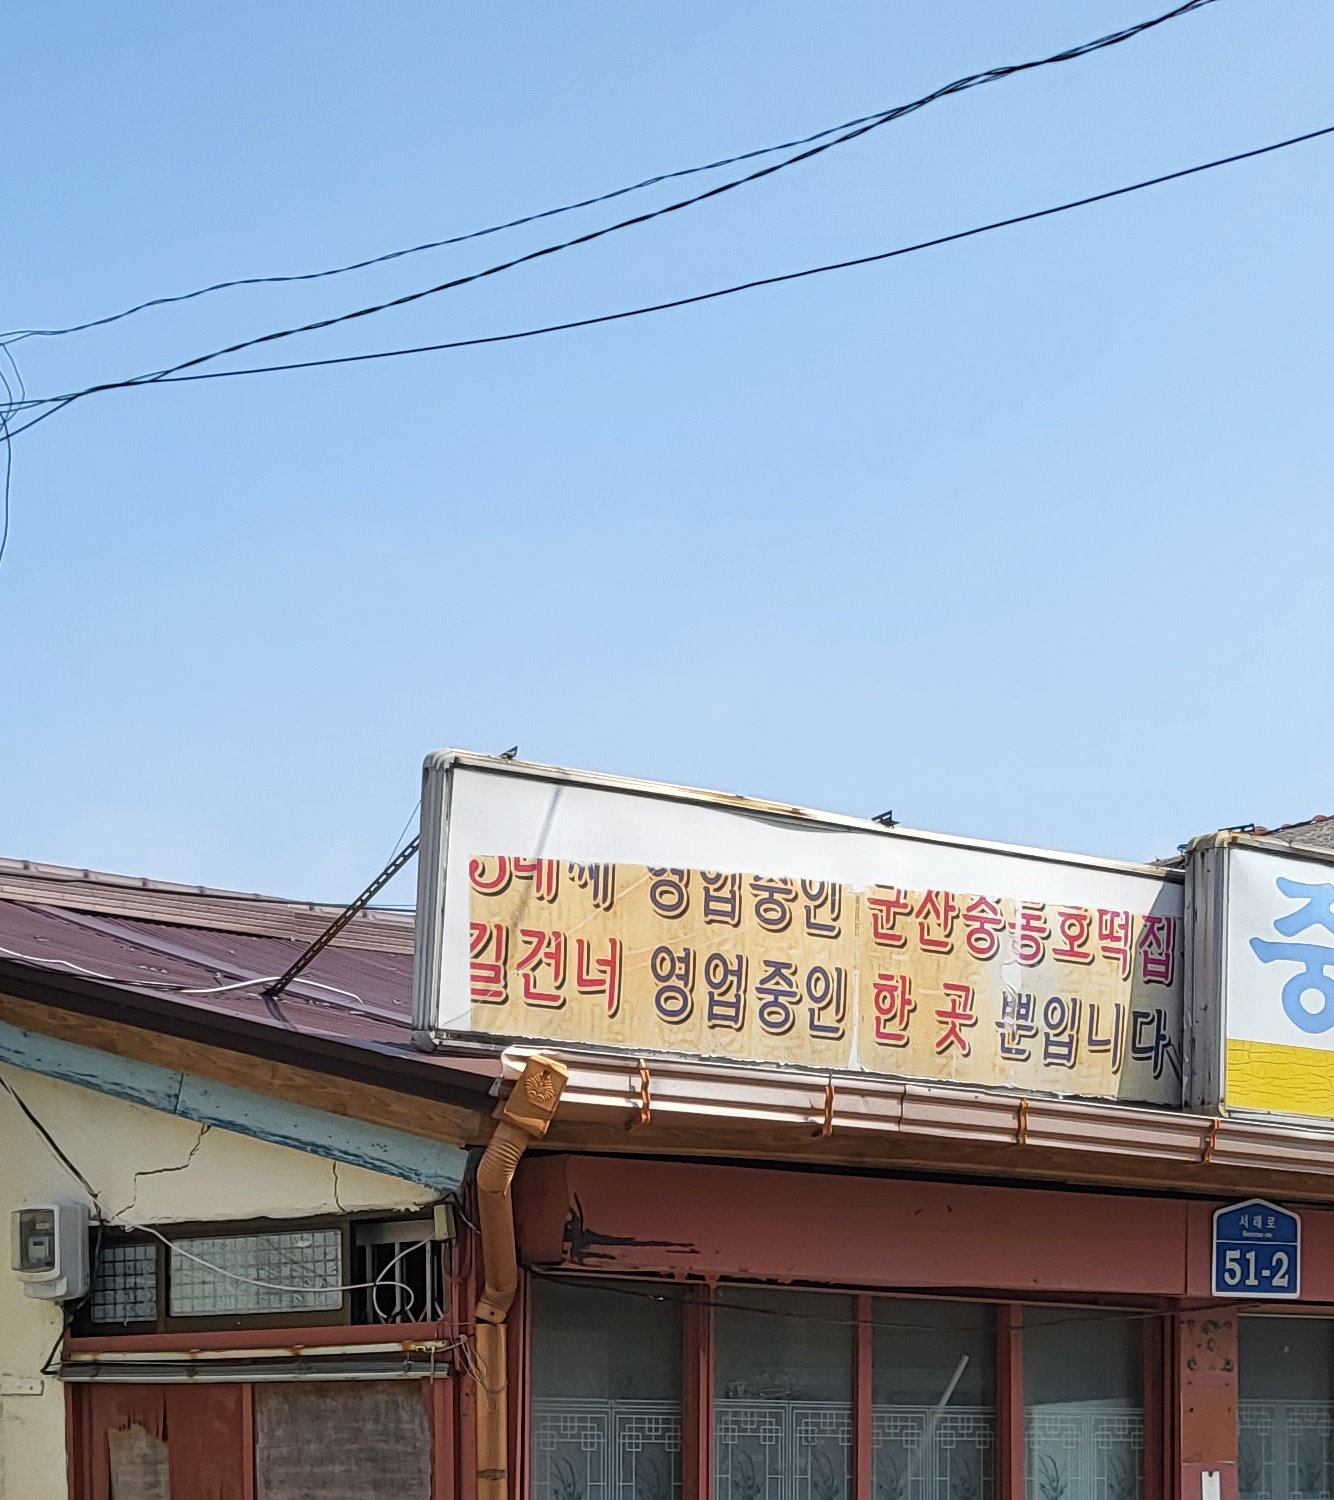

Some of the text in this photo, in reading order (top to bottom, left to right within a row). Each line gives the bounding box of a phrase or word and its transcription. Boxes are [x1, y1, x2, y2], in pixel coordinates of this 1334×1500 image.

[469, 921, 1167, 1076] 길건너 영업중인 한 곳 뿐입니다
[1224, 1249, 1289, 1287] 51-2
